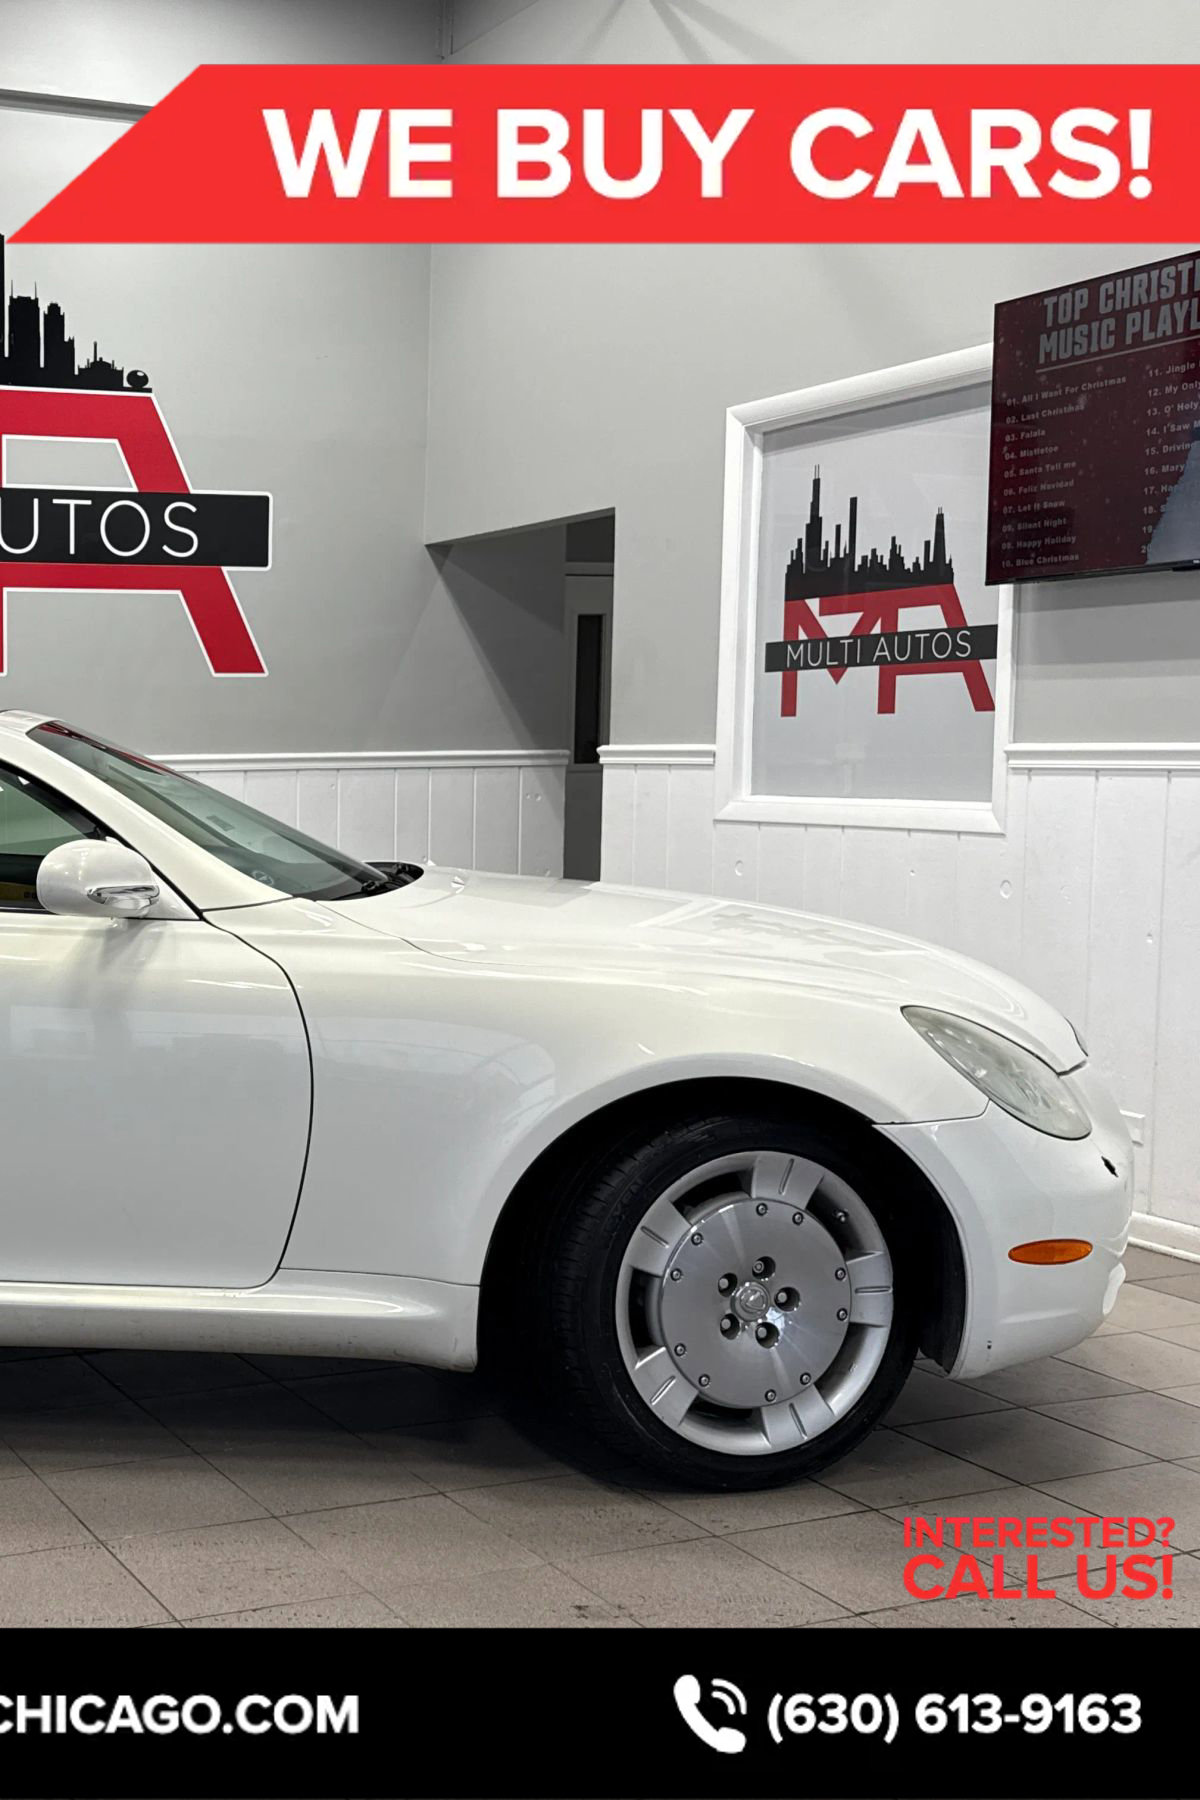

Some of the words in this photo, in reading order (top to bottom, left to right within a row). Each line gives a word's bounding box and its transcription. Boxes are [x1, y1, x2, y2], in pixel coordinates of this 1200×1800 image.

[1044, 287, 1089, 328] TOP
[1038, 317, 1116, 364] MUSIC
[1166, 361, 1196, 374] Jingle
[1022, 394, 1033, 403] All
[1041, 389, 1062, 399] Want
[1065, 385, 1079, 395] For
[1081, 376, 1127, 391] Christmas
[1148, 388, 1162, 397] 12.
[1165, 384, 1179, 395] My
[1021, 412, 1040, 421] Last
[1042, 403, 1085, 417] Christmas
[1177, 401, 1200, 412] Holy
[1020, 429, 1046, 440] Falala
[1147, 427, 1160, 436] 14.
[1170, 422, 1190, 432] Saw
[1020, 446, 1059, 457] Mistletoe
[1019, 465, 1043, 476] Santa
[1045, 462, 1061, 472] Tell
[1063, 461, 1077, 469] me
[1161, 464, 1184, 473] Mary
[1019, 484, 1038, 495] Feliz
[1040, 479, 1075, 491] Navidad
[1018, 502, 1032, 512] Let
[1043, 499, 1066, 509] Snow
[1017, 520, 1041, 531] Silent
[1044, 517, 1067, 528] Night
[1016, 539, 1042, 550] Happy
[1016, 557, 1034, 567] Blue
[1036, 553, 1079, 564] Christmas
[786, 638, 861, 669] MULTI
[872, 630, 972, 663] AUTOS
